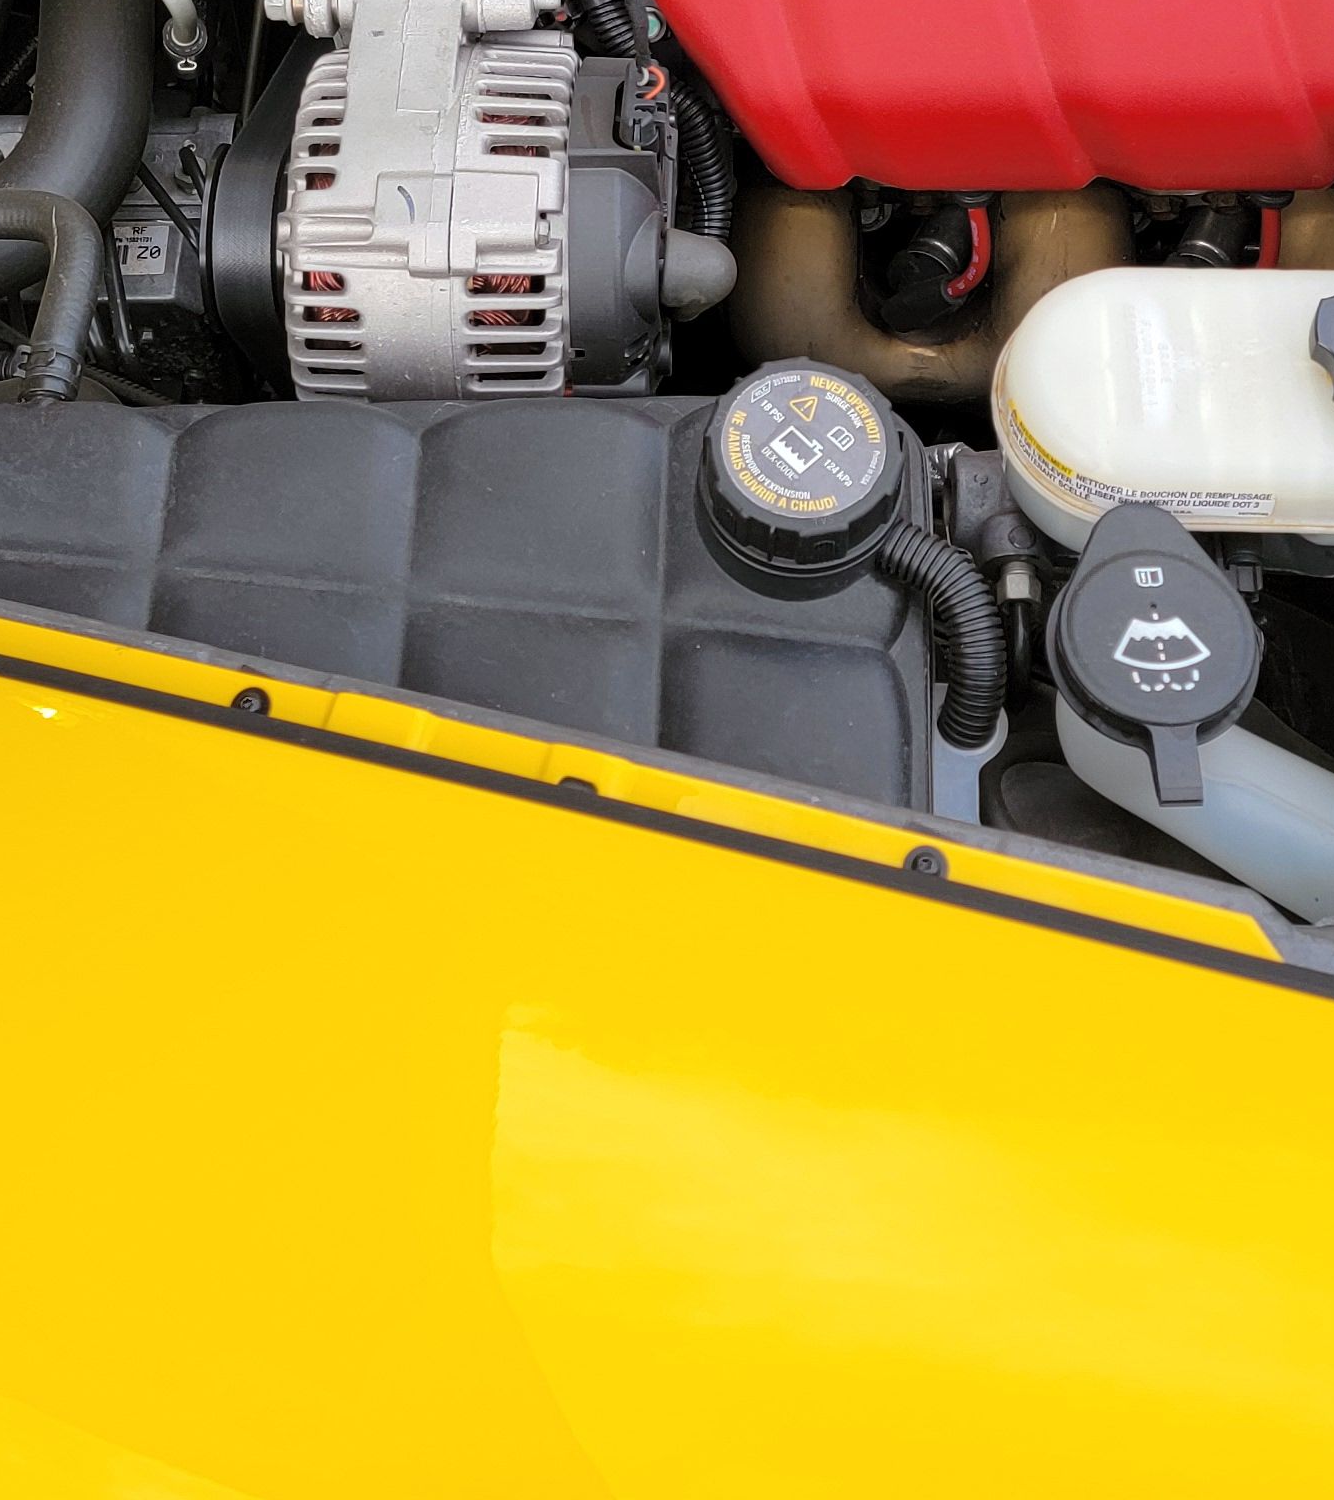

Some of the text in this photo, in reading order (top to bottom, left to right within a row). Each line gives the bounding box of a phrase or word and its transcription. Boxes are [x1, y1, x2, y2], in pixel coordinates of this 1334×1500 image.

[132, 226, 148, 235] RF
[731, 410, 747, 427] NE
[760, 399, 786, 423] 18 PSI
[810, 375, 881, 443] NEVER OPEN HOT!
[825, 391, 864, 429] SURGE TANK
[728, 426, 746, 470] JAMAIS
[739, 470, 777, 504] OUVRIR
[824, 459, 853, 487] 124 kPa
[1075, 473, 1123, 495] NETTOYER
[1126, 488, 1137, 498] LE
[1140, 491, 1187, 499] BOUCHON
[1205, 492, 1272, 501] REMPLISSAGE
[790, 494, 839, 511] CHAUD!
[1076, 481, 1115, 501] UTILISER
[1177, 499, 1190, 507] DU
[1192, 500, 1230, 508] LIQUIDE
[1232, 501, 1252, 509] DOT
